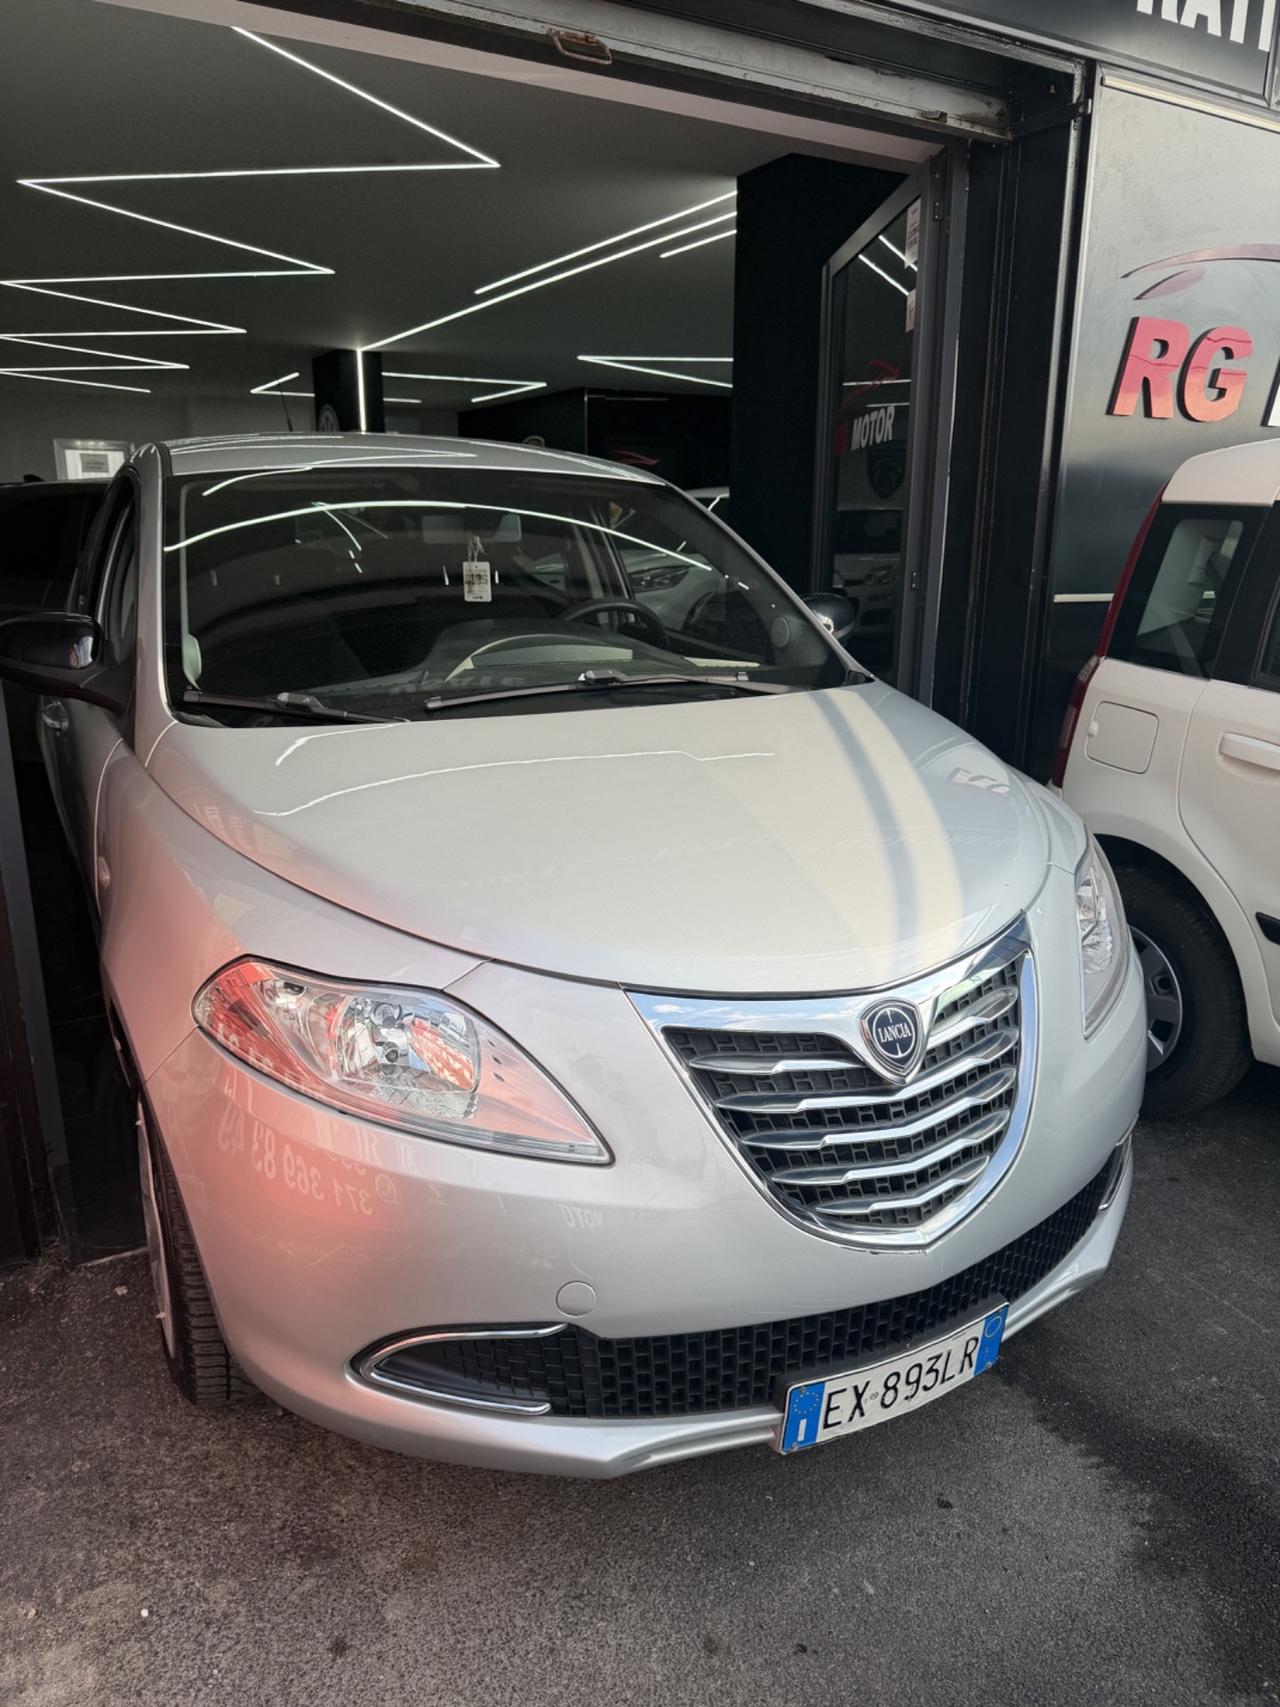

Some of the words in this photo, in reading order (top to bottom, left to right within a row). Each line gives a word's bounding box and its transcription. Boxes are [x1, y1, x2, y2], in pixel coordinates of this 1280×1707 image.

[1105, 316, 1254, 423] RG
[850, 405, 896, 451] MOTOR
[878, 1022, 912, 1043] LANCIA
[823, 1380, 871, 1430] EX
[880, 1336, 979, 1409] 893LR
